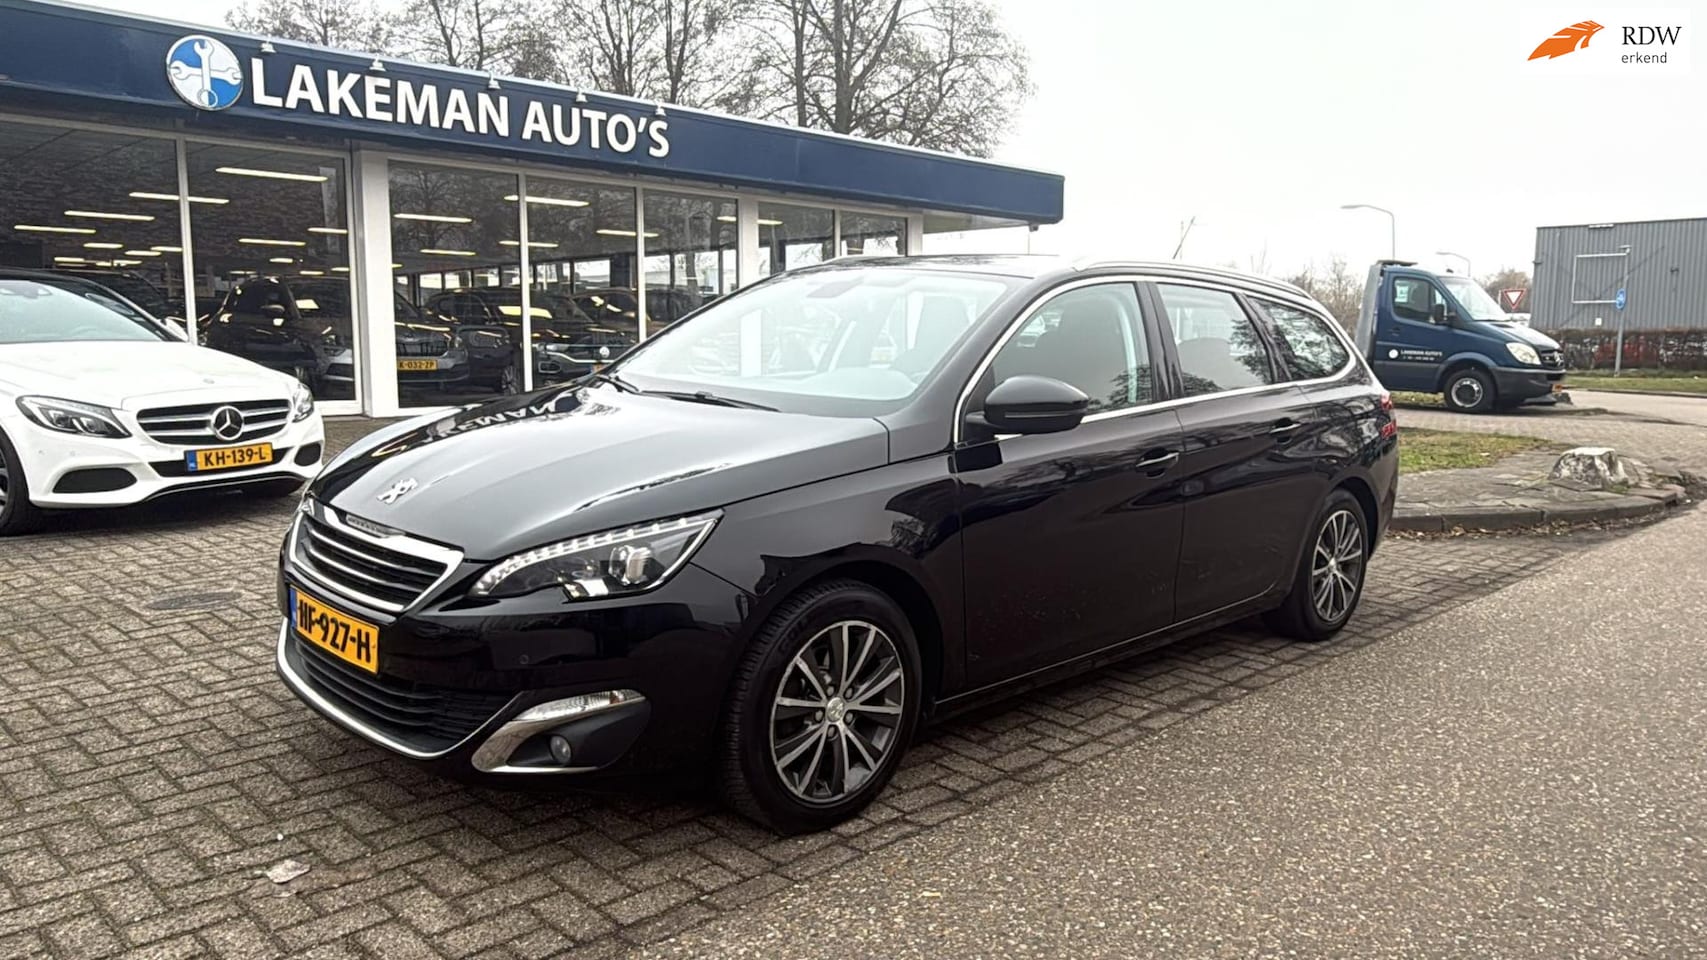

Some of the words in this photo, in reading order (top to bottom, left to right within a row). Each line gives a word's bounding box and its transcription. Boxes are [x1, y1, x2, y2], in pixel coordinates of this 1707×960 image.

[251, 58, 510, 137] LAKEMAN
[522, 101, 671, 157] AUTO'S
[203, 446, 266, 467] KH-139-L
[299, 599, 371, 663] HF-927-H
